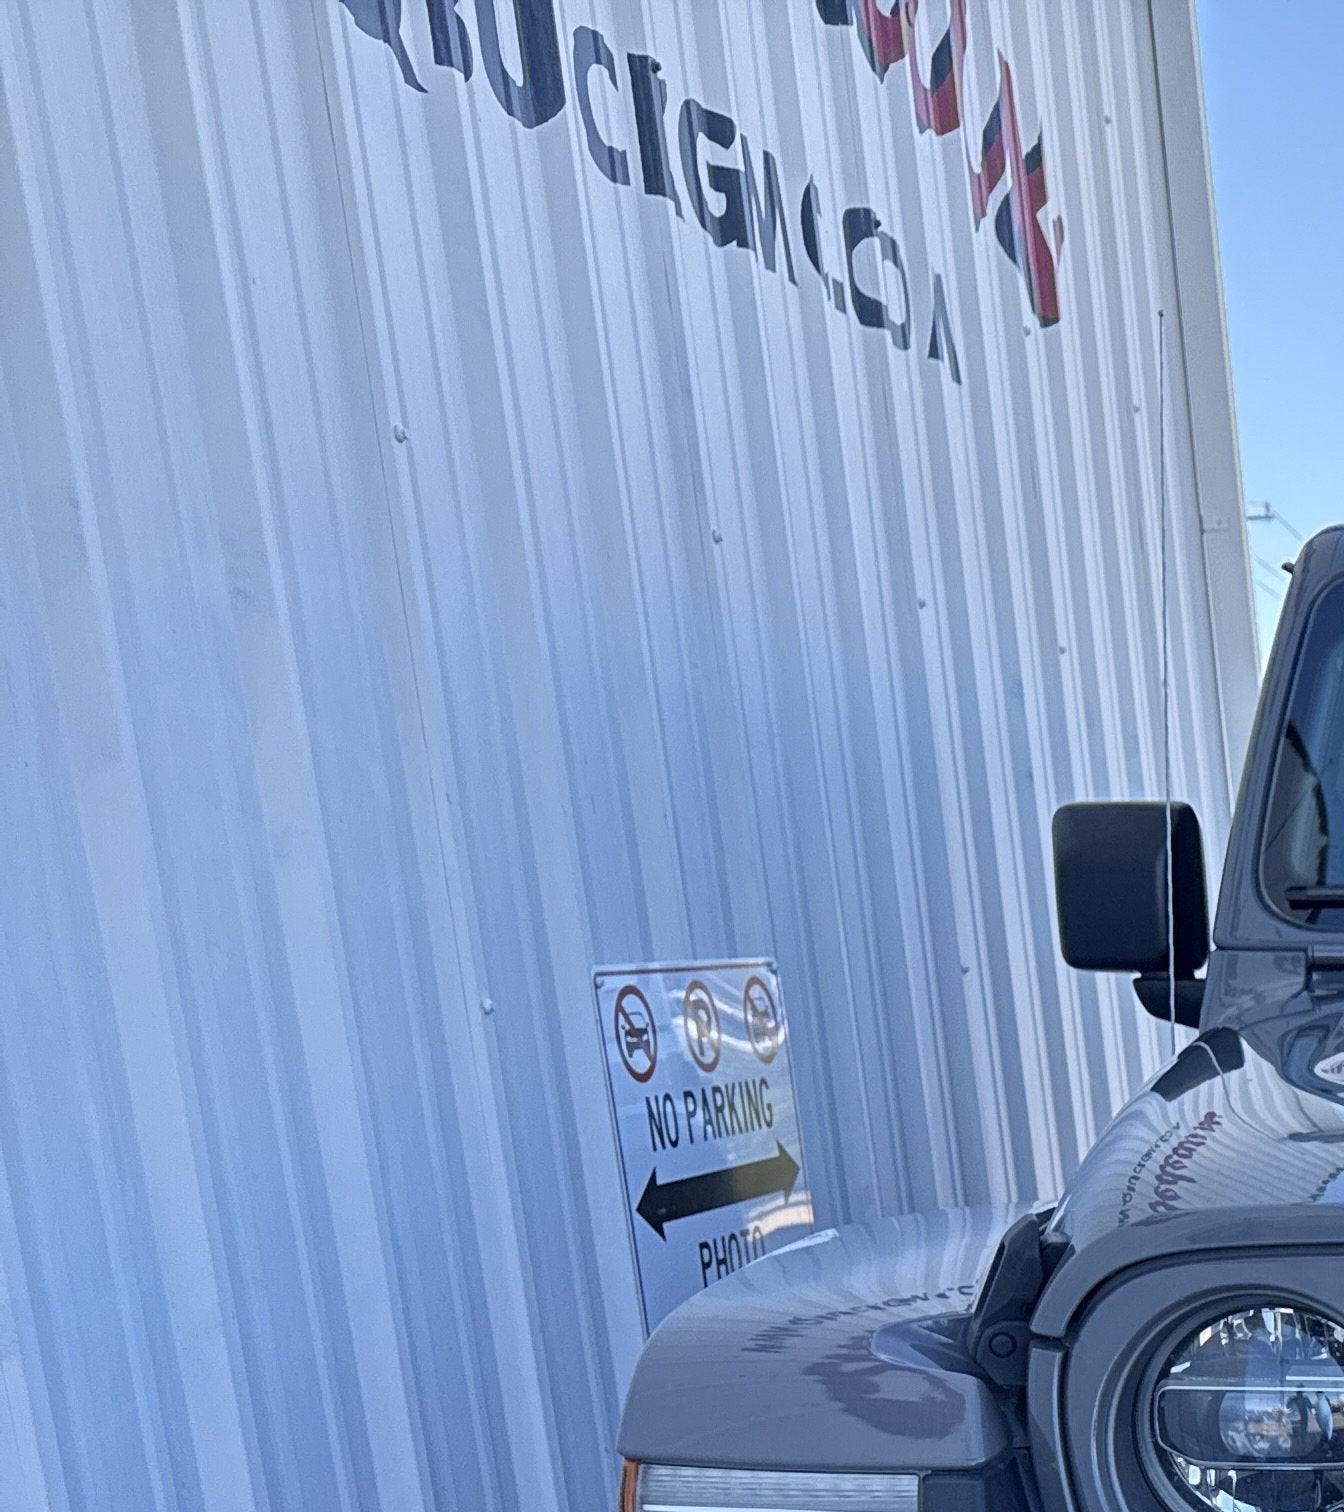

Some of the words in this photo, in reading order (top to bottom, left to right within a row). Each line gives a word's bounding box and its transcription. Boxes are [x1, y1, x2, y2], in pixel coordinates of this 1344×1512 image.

[645, 1093, 679, 1152] NO
[683, 1077, 773, 1144] PARKING
[699, 1225, 766, 1288] PHOTO
